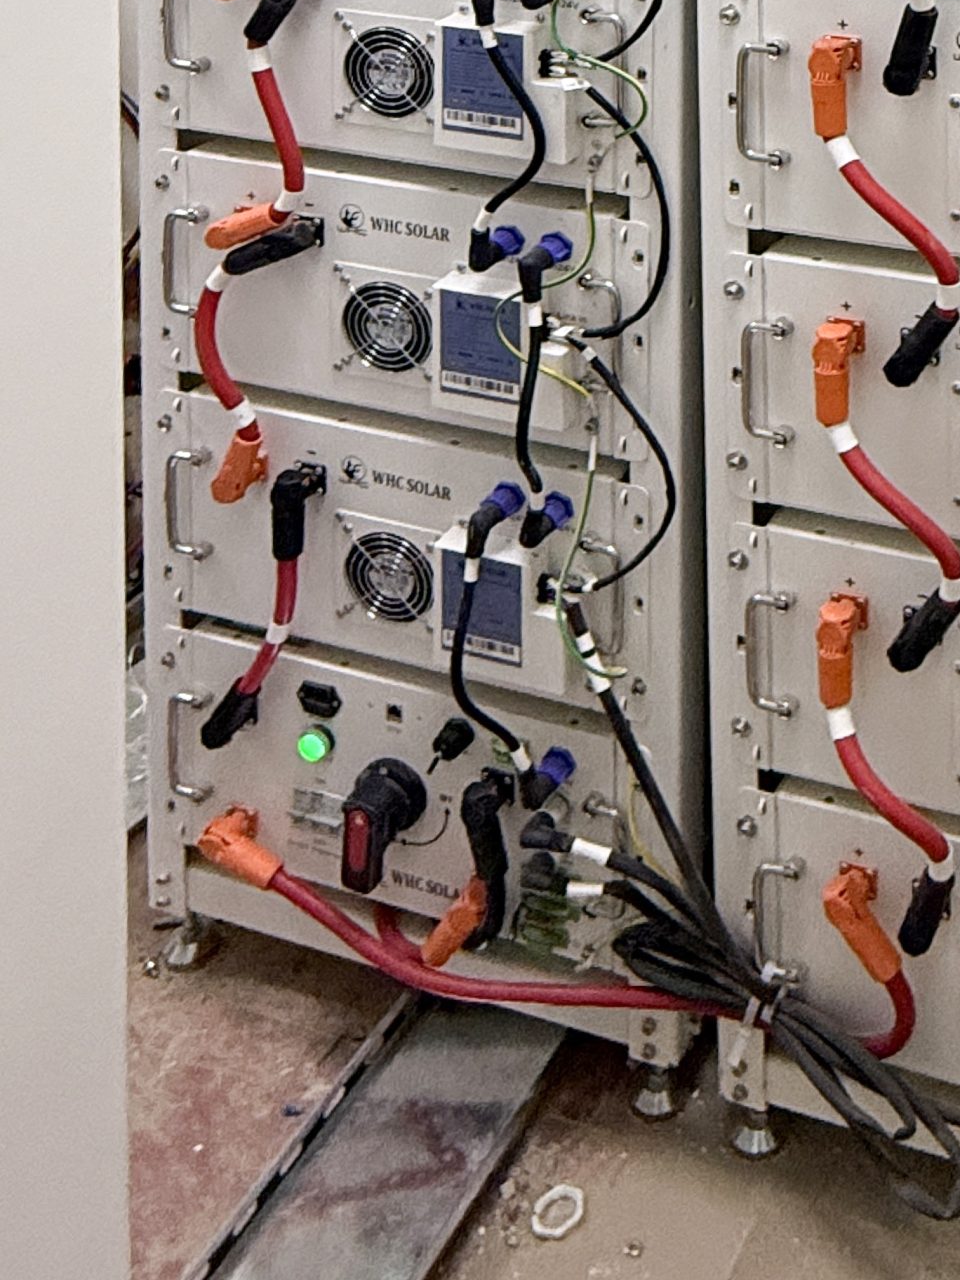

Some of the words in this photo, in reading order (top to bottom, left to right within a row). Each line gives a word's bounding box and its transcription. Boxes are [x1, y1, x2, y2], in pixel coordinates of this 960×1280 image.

[371, 216, 403, 233] WHC
[406, 222, 450, 241] SOLAR
[372, 470, 405, 488] WHC
[407, 478, 451, 500] SOLAR
[392, 869, 424, 889] WHC
[426, 877, 460, 898] SOLA
